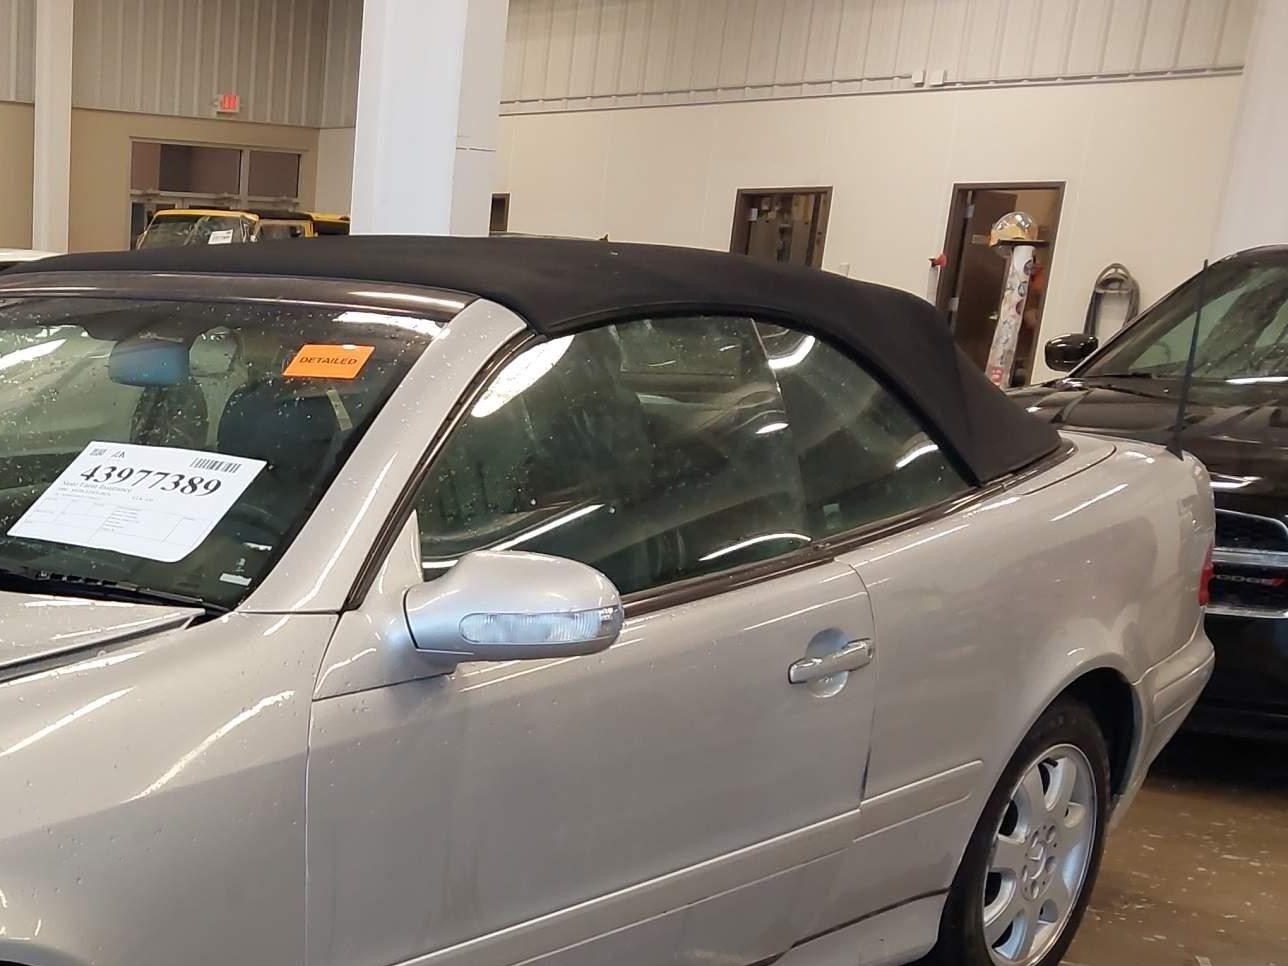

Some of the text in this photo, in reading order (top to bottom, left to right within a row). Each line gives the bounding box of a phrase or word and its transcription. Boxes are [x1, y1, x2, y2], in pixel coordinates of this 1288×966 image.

[299, 356, 357, 365] DETAILED
[80, 464, 222, 497] 43977389
[1215, 574, 1273, 585] ODGE
